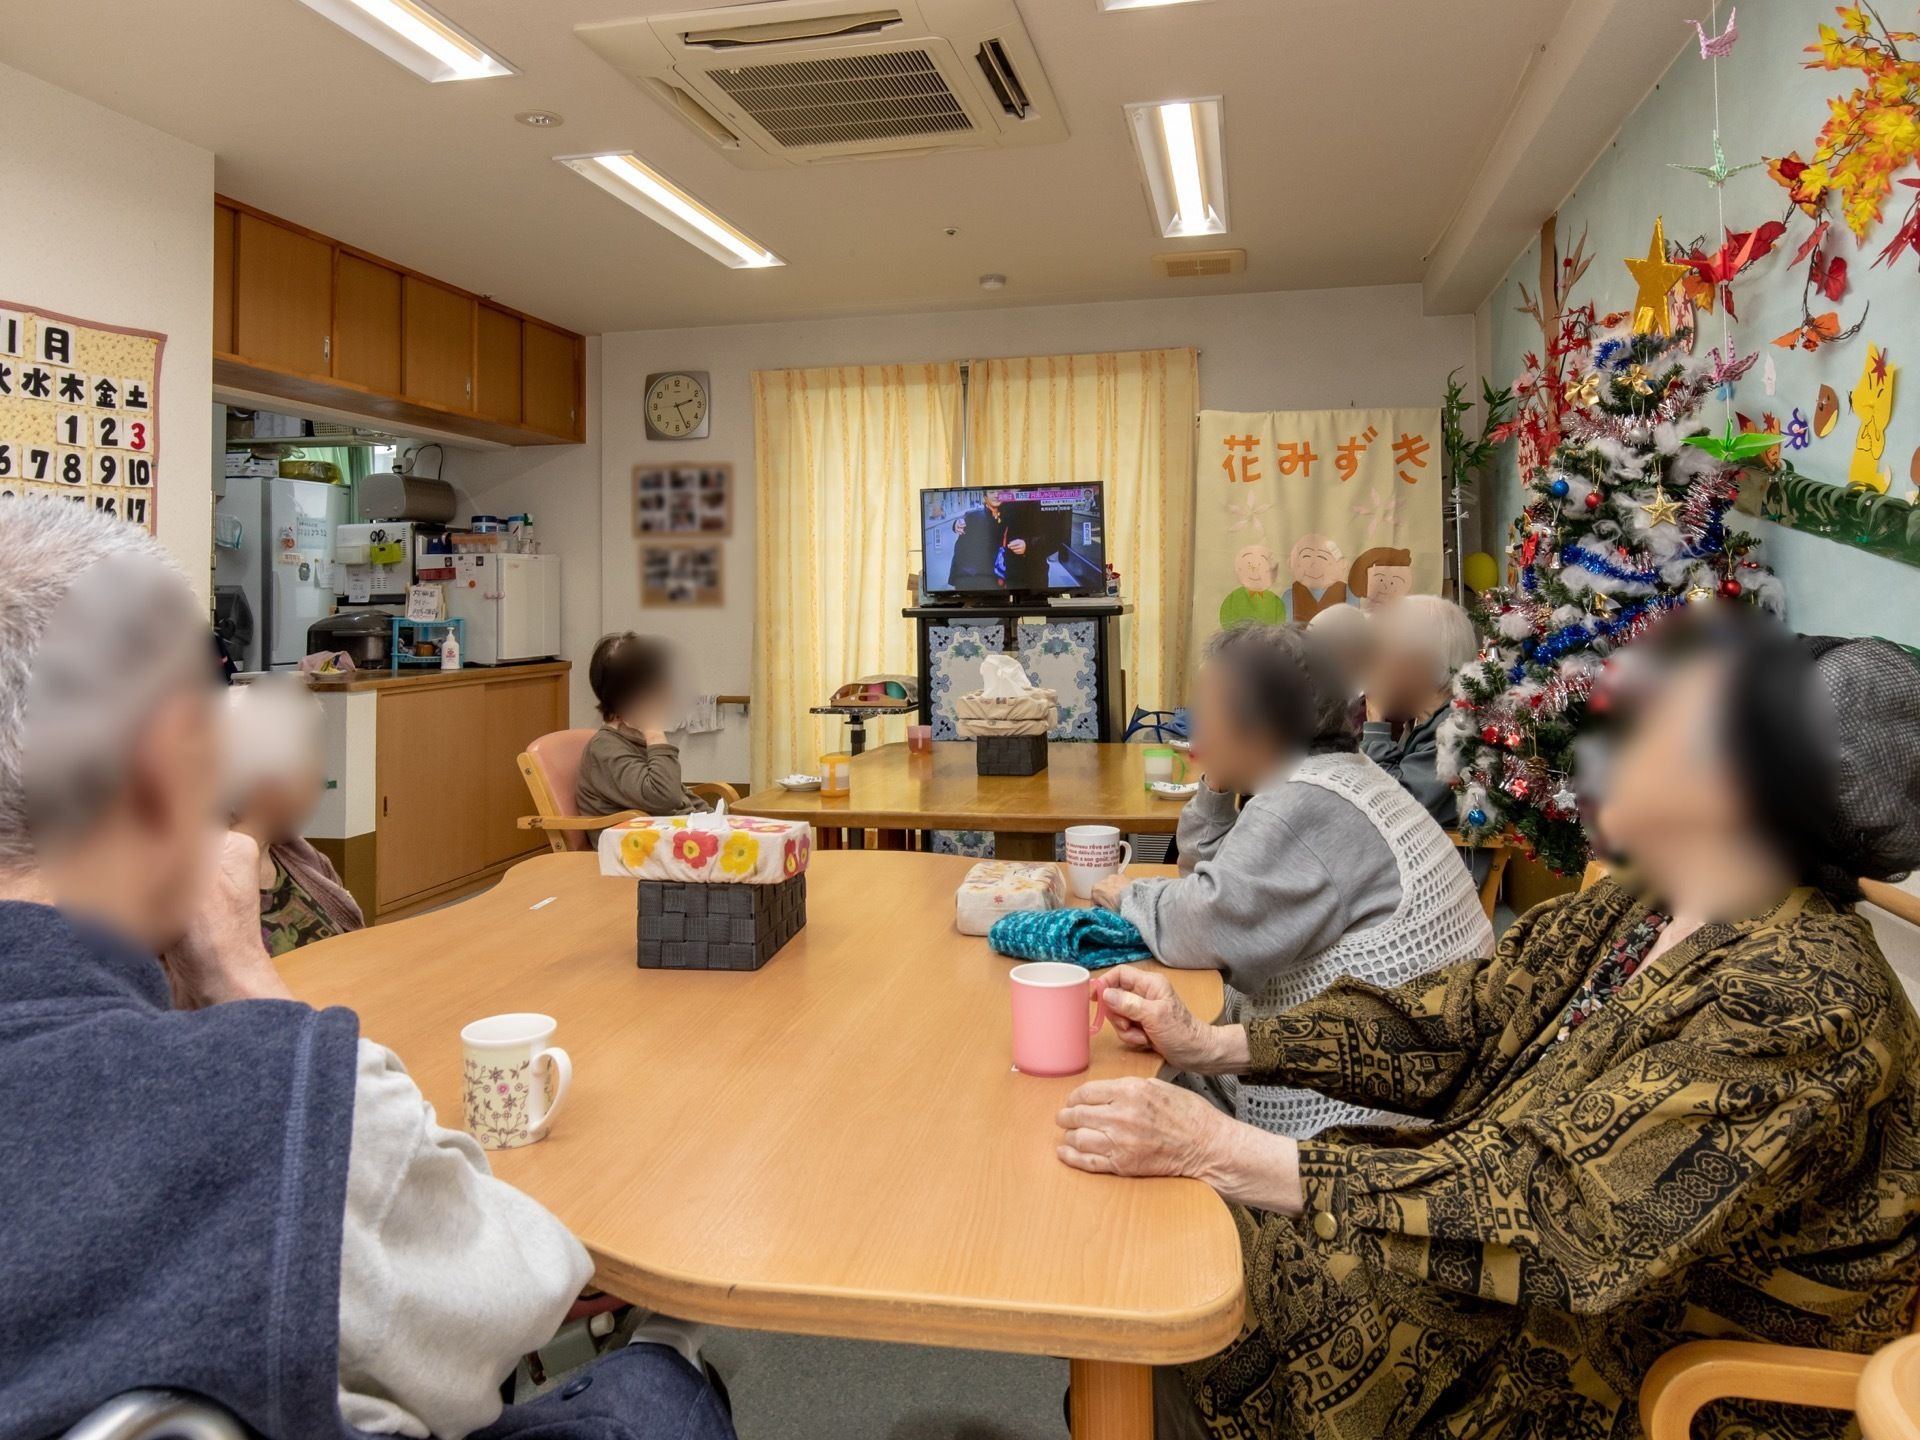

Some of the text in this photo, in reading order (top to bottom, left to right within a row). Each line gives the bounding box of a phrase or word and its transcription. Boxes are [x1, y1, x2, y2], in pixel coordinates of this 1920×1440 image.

[65, 415, 146, 450] 1 2 3
[31, 449, 49, 479] 7
[63, 453, 81, 483] 8
[100, 455, 116, 484] 9
[129, 459, 150, 485] 10
[1222, 426, 1430, 484] 花みずき
[127, 498, 146, 523] 17
